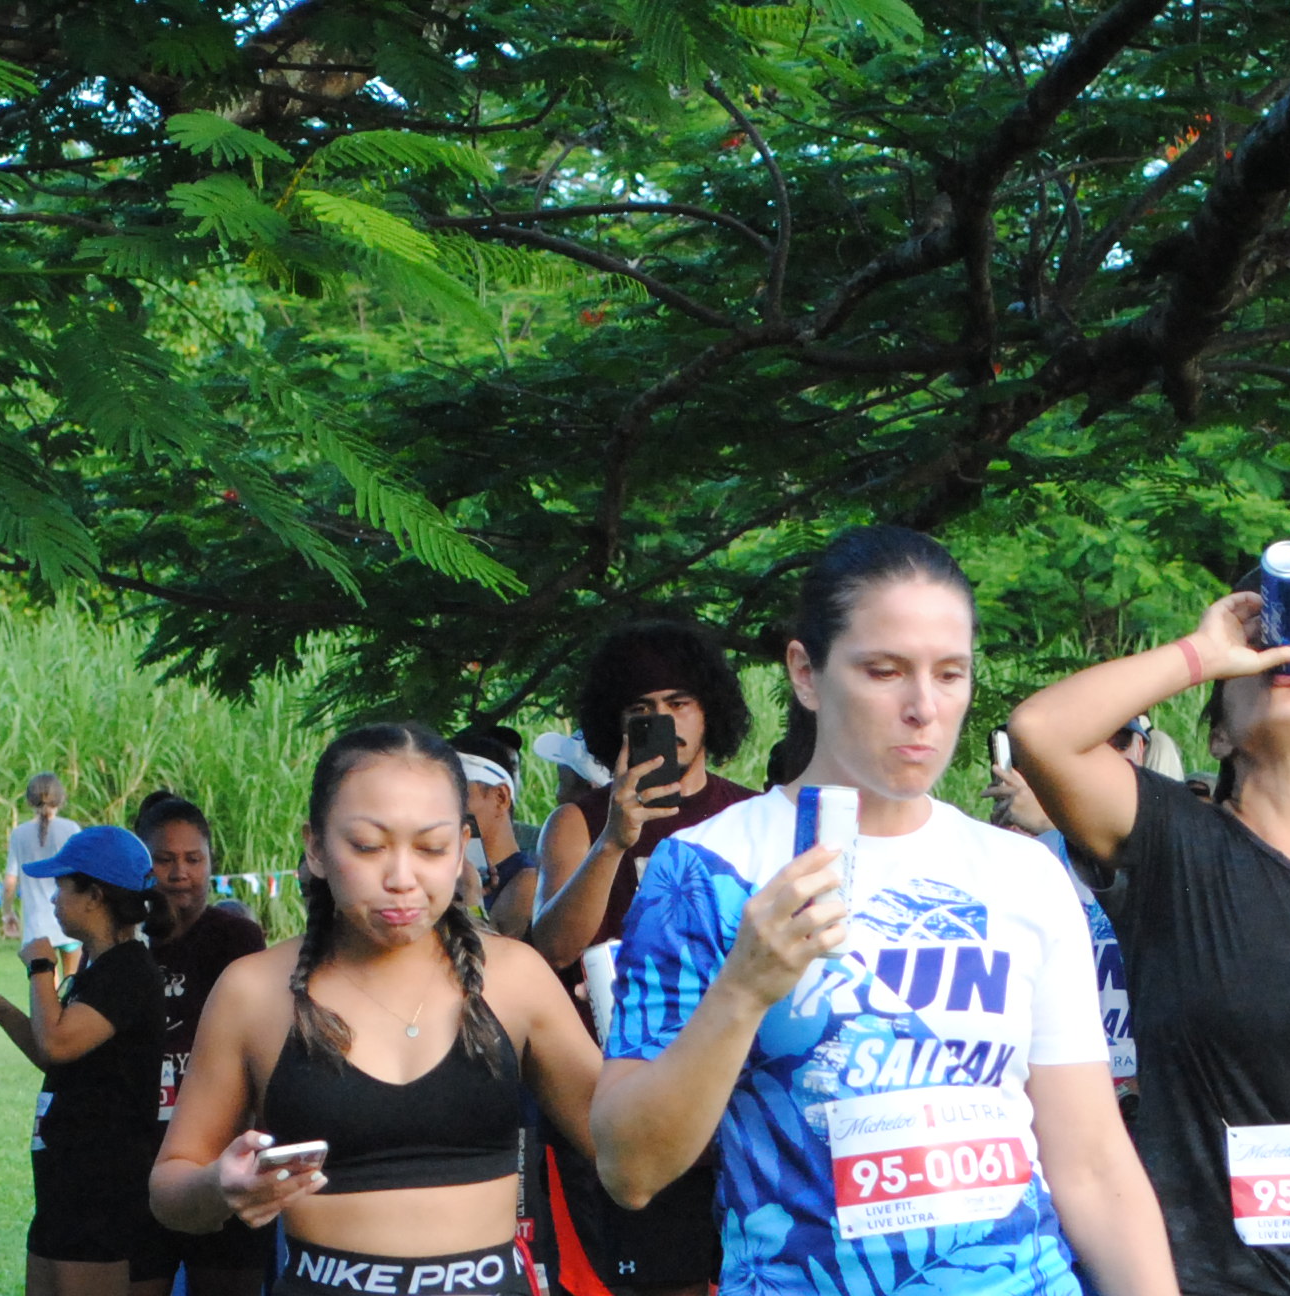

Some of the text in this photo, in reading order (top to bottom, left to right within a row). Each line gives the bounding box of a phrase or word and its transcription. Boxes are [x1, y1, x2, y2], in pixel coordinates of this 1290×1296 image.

[790, 947, 1011, 1018] RUN
[846, 1038, 1016, 1088] SAIPAN
[940, 1104, 1009, 1125] ULTRA
[851, 1142, 1016, 1198] 95-0061
[865, 1201, 917, 1217] LIVE FIT.
[867, 1212, 940, 1230] LIVE ULTRA.
[1257, 1220, 1280, 1228] LIVE
[1258, 1231, 1280, 1239] LIVE
[296, 1250, 404, 1294] NIKE
[407, 1254, 505, 1294] PRO
